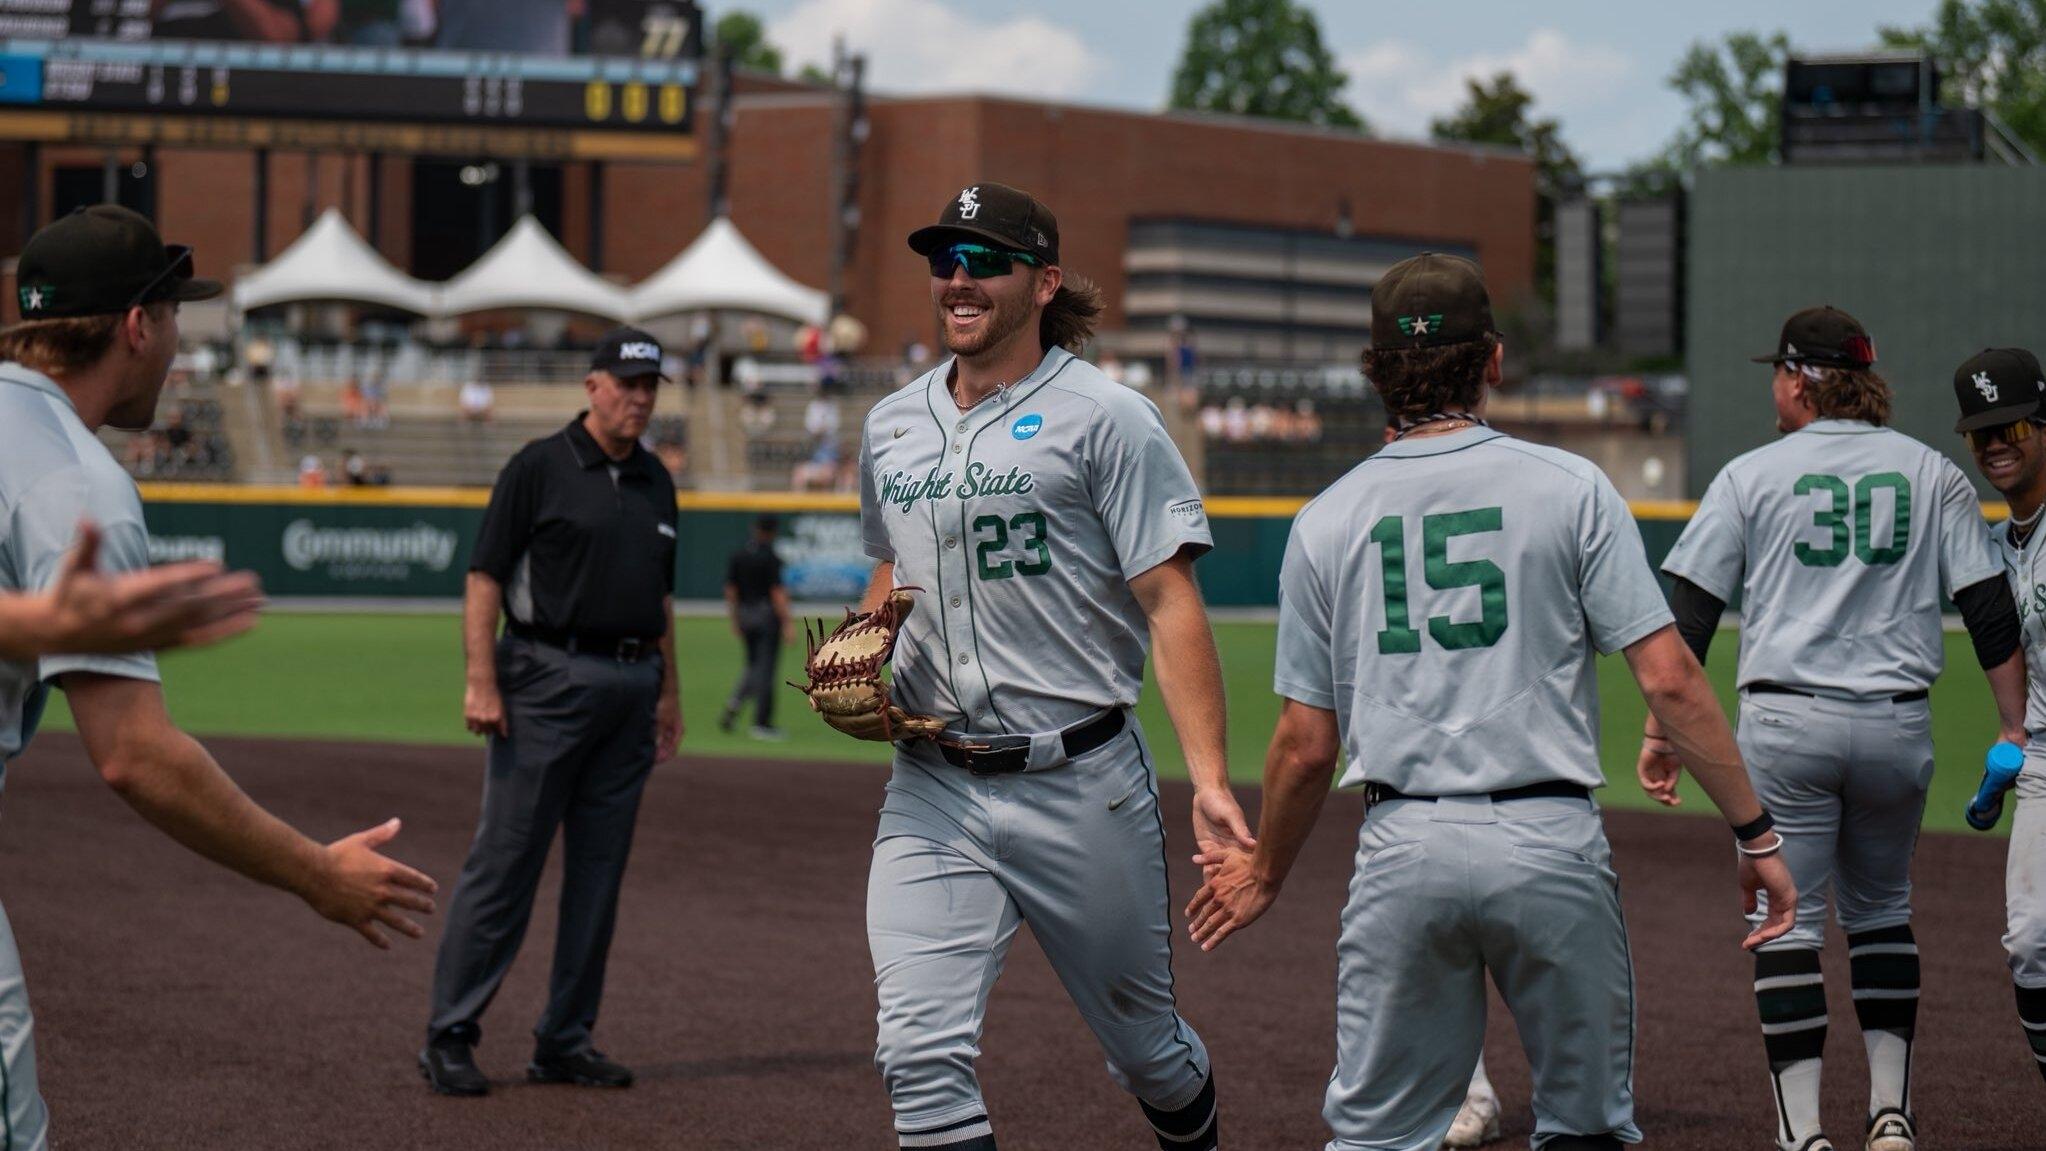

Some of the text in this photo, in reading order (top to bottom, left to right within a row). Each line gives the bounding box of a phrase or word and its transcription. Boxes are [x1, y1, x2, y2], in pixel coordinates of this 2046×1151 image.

[958, 186, 982, 220] WSU
[1014, 424, 1040, 433] NCAA
[881, 461, 1034, 514] Wright State
[973, 511, 1052, 581] 23
[1793, 472, 1911, 567] 30
[1370, 506, 1509, 655] 15
